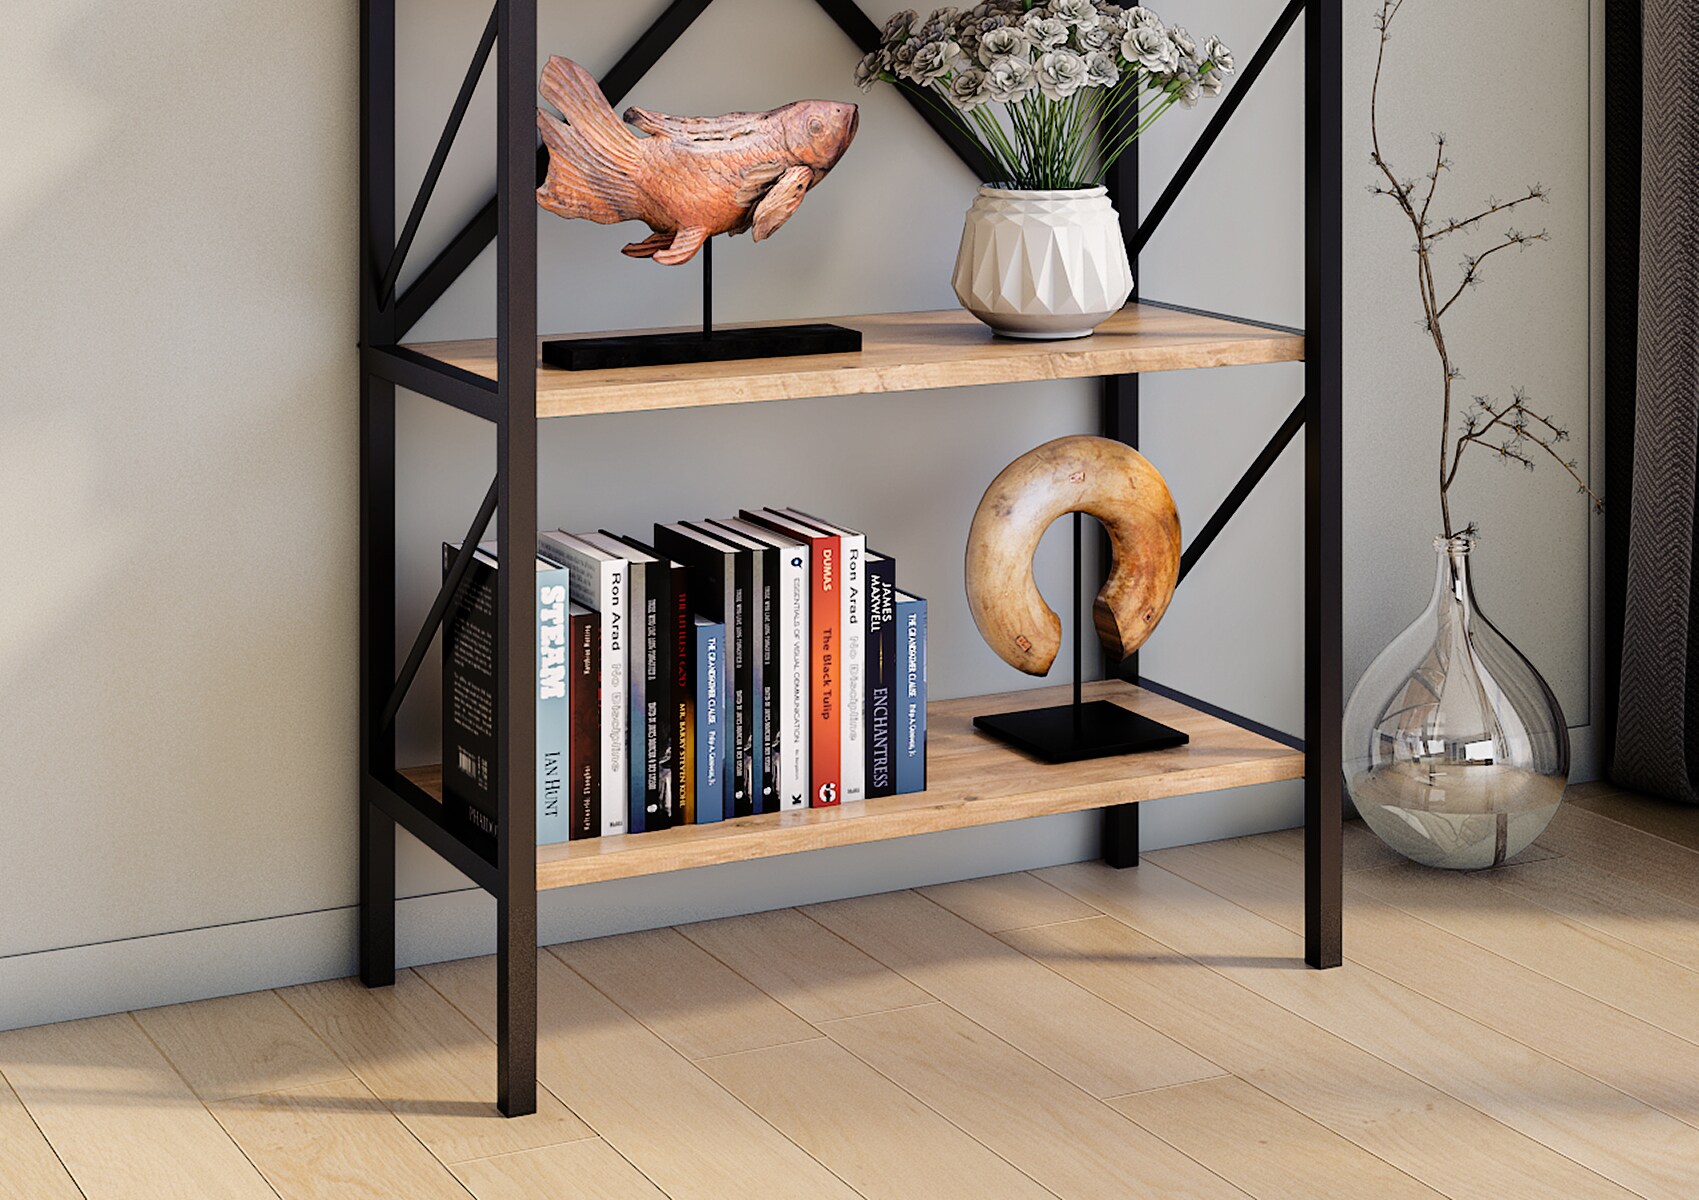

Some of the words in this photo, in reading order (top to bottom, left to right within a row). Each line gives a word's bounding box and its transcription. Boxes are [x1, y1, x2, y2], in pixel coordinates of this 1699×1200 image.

[822, 549, 832, 592] DUMAS
[850, 549, 858, 582] Ron
[612, 572, 621, 606] Ron
[793, 578, 801, 627] ESSENTIALS
[850, 586, 858, 625] Arad
[870, 575, 881, 633] MAXWELL
[881, 582, 892, 622] JAMES
[612, 611, 621, 651] Arad
[793, 629, 801, 640] OF
[908, 613, 916, 627] THE
[540, 584, 565, 699] STEAM
[708, 638, 716, 651] THE
[793, 642, 801, 670] VISUAL
[821, 628, 832, 651] The
[850, 636, 858, 660] No
[612, 662, 621, 689] No
[821, 654, 832, 687] Black
[793, 672, 801, 743] COMMUNICATION
[821, 689, 832, 720] Tulip
[848, 664, 859, 741] Discipline
[609, 691, 622, 772] Discipline
[679, 721, 687, 748] BARRY
[873, 687, 888, 788] ENCHANTRESS
[545, 751, 560, 775] IAN
[679, 750, 687, 783] STEVEN
[545, 778, 560, 817] HUNT
[679, 784, 687, 809] KOHL
